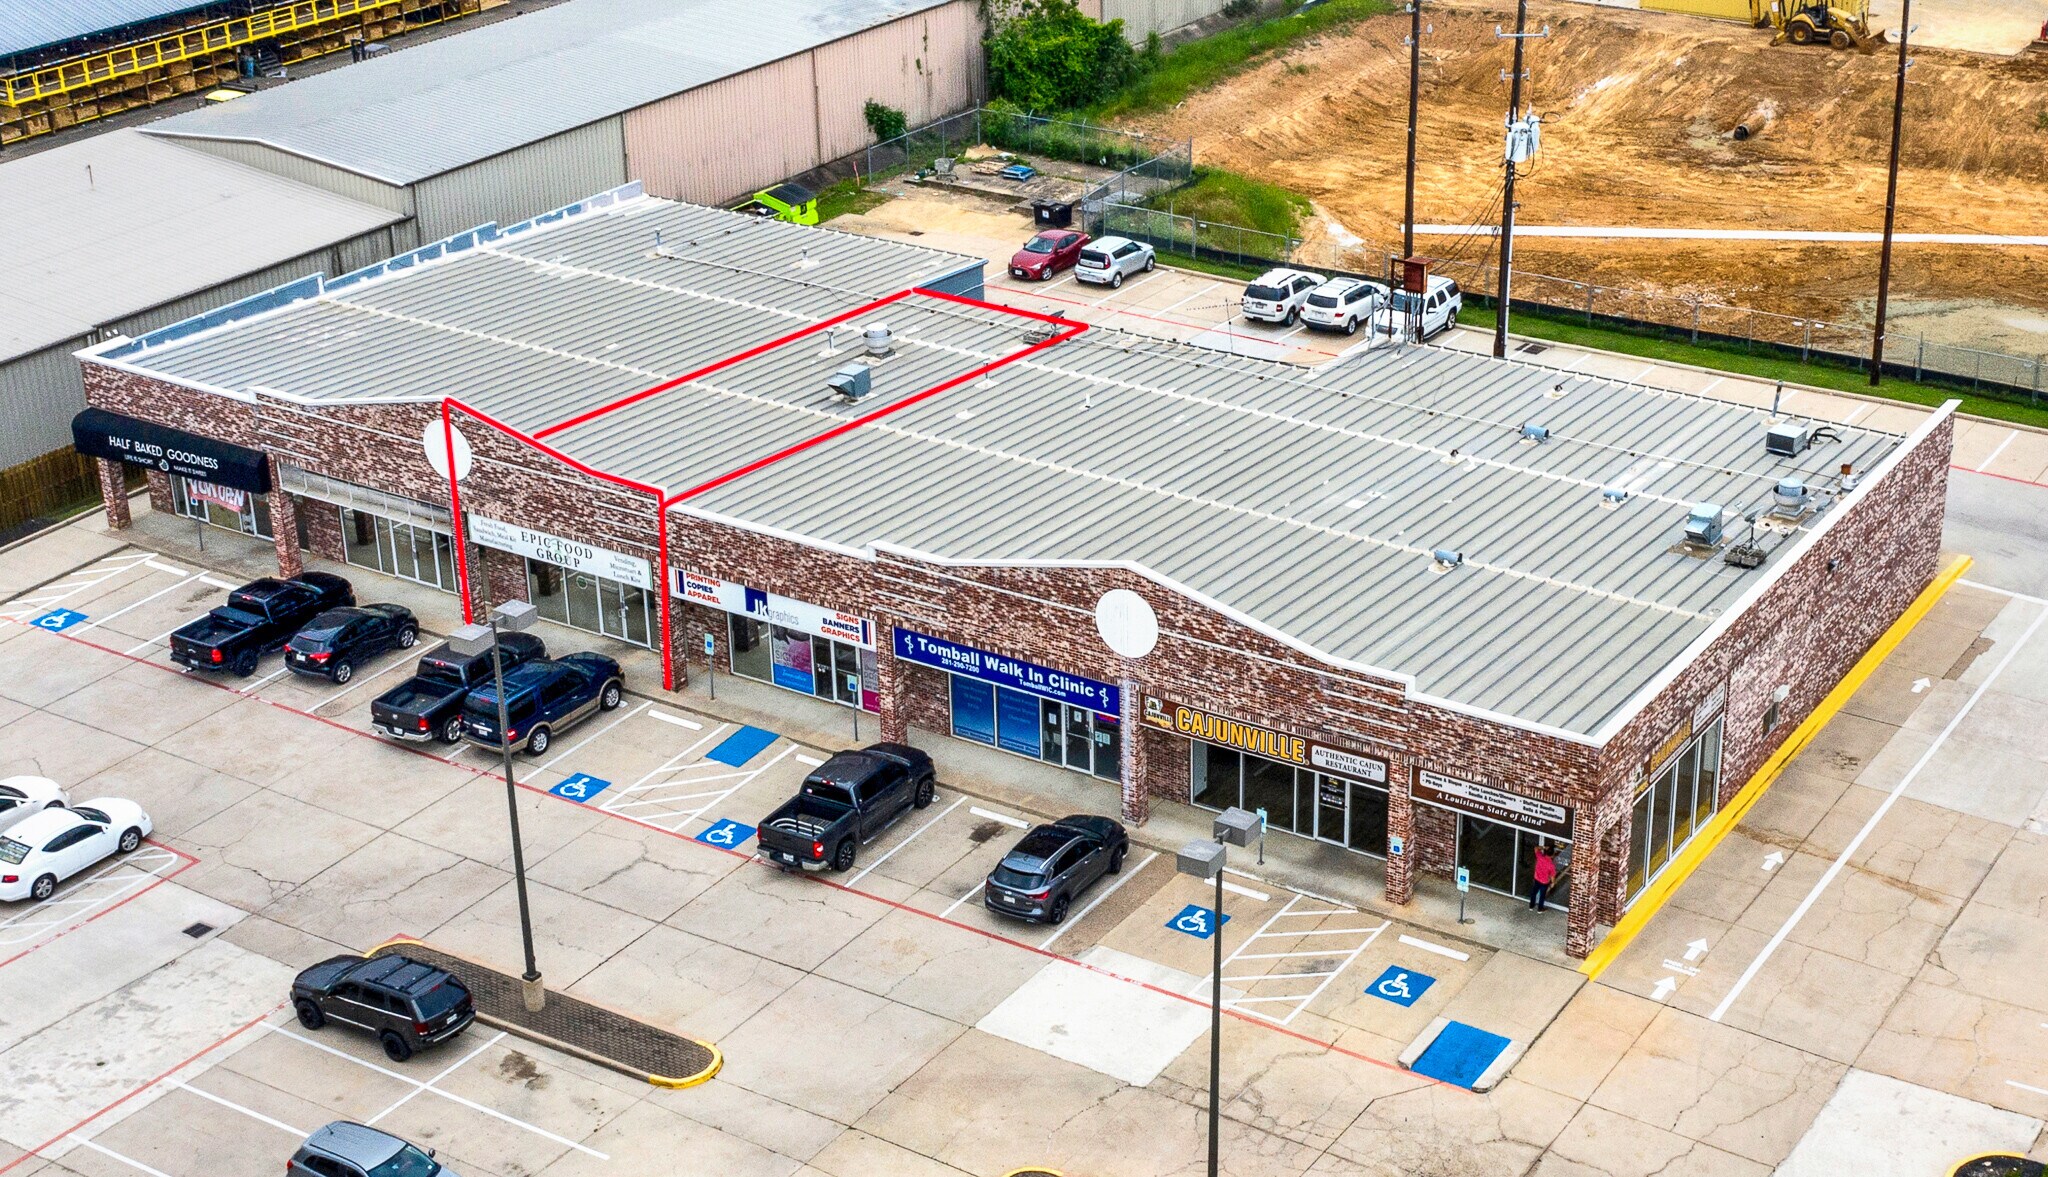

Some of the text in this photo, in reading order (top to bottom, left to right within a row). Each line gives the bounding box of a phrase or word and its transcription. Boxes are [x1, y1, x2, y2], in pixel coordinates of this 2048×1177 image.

[109, 436, 218, 469] HALF BAKED GOODNESS
[521, 531, 593, 560] EPIC FOOD
[536, 547, 580, 568] GROUP
[686, 572, 721, 587] PRINTING
[686, 581, 714, 594] COPIES
[687, 590, 721, 604] APPAREL
[822, 617, 860, 634] BANNERS
[836, 613, 859, 625] SIGNS
[821, 626, 861, 643] GRAPHICS
[918, 637, 1095, 697] Tomball Walk In Clinic
[1176, 706, 1306, 765] CAJUNVILLE
[1314, 749, 1383, 772] AUTHENTIC CAJUN
[1325, 759, 1372, 777] RESTAURANT
[1436, 792, 1443, 800] A
[1444, 794, 1485, 811] Louisiana
[1486, 806, 1508, 818] State
[1509, 812, 1520, 822] of
